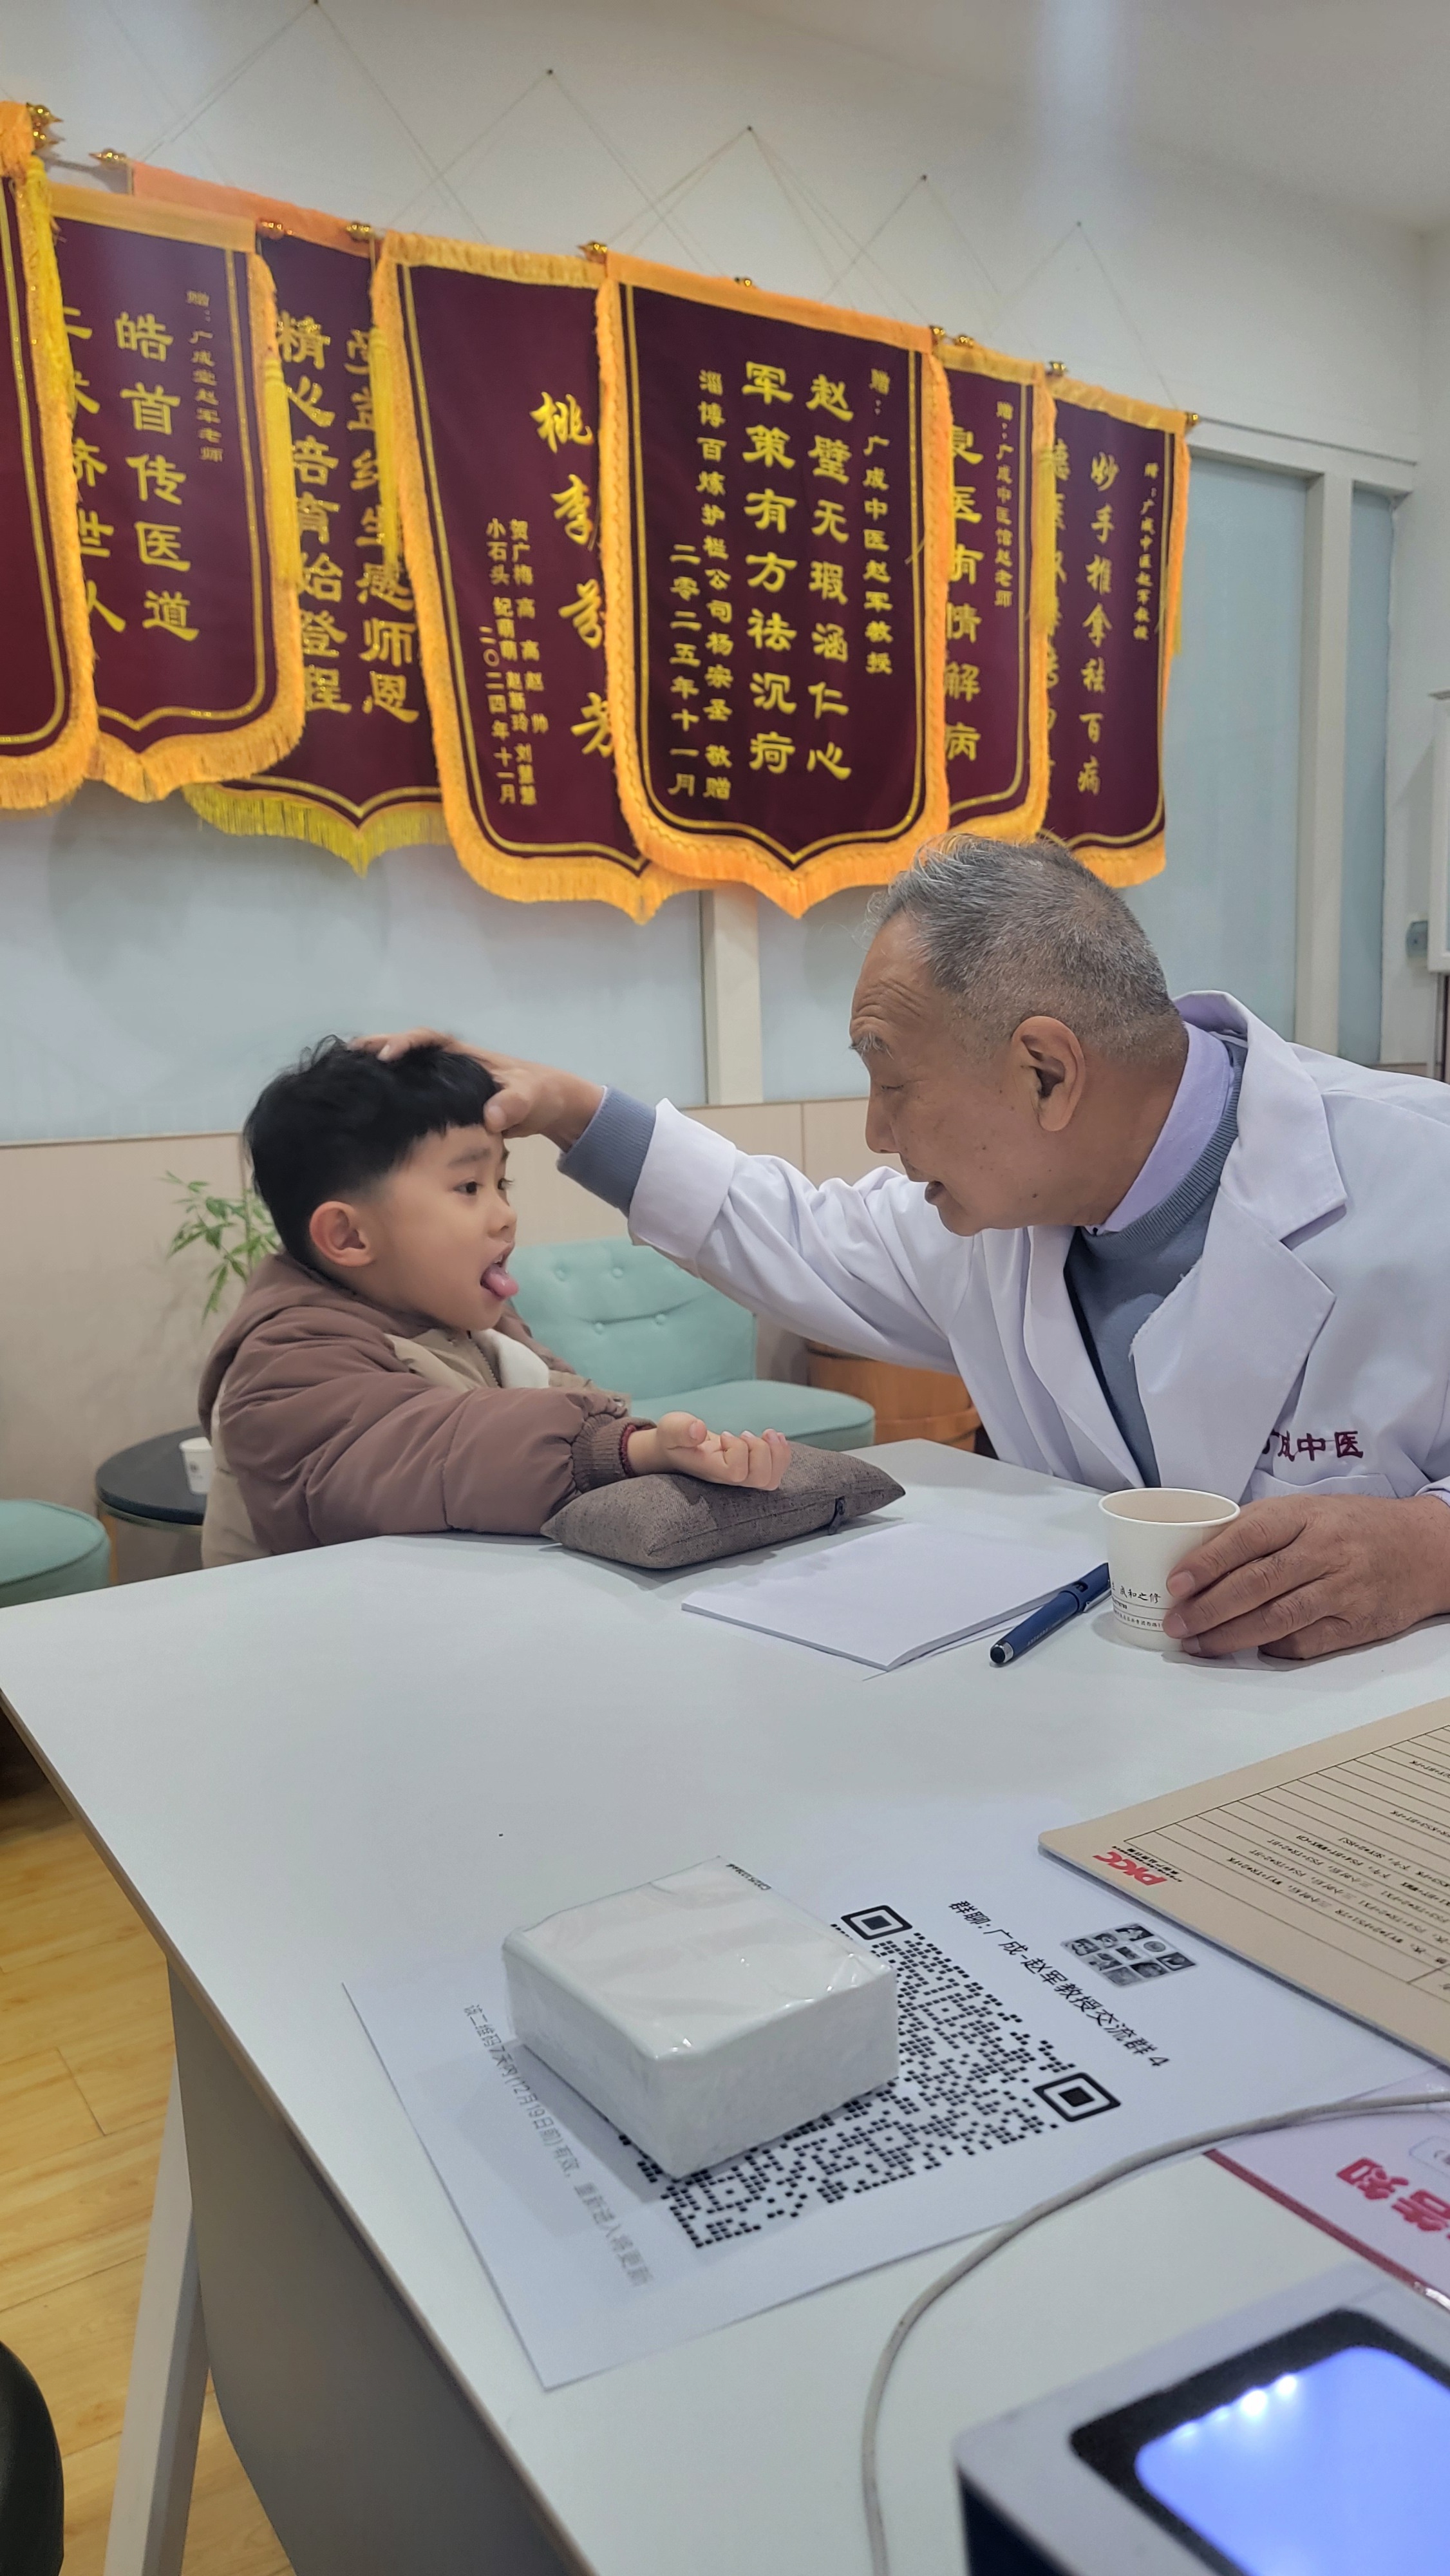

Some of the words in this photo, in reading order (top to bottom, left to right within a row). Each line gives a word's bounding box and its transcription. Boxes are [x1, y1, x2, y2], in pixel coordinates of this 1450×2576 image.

[115, 311, 199, 641] 皓首传医道
[486, 517, 511, 586] 小石头
[741, 361, 798, 774] 军策有方祛沉疴
[667, 543, 702, 798] 二零二五年十一月
[1077, 450, 1120, 796] 妙手推拿祛百病
[702, 743, 733, 800] 敬赠
[1092, 1851, 1167, 1886] PICC
